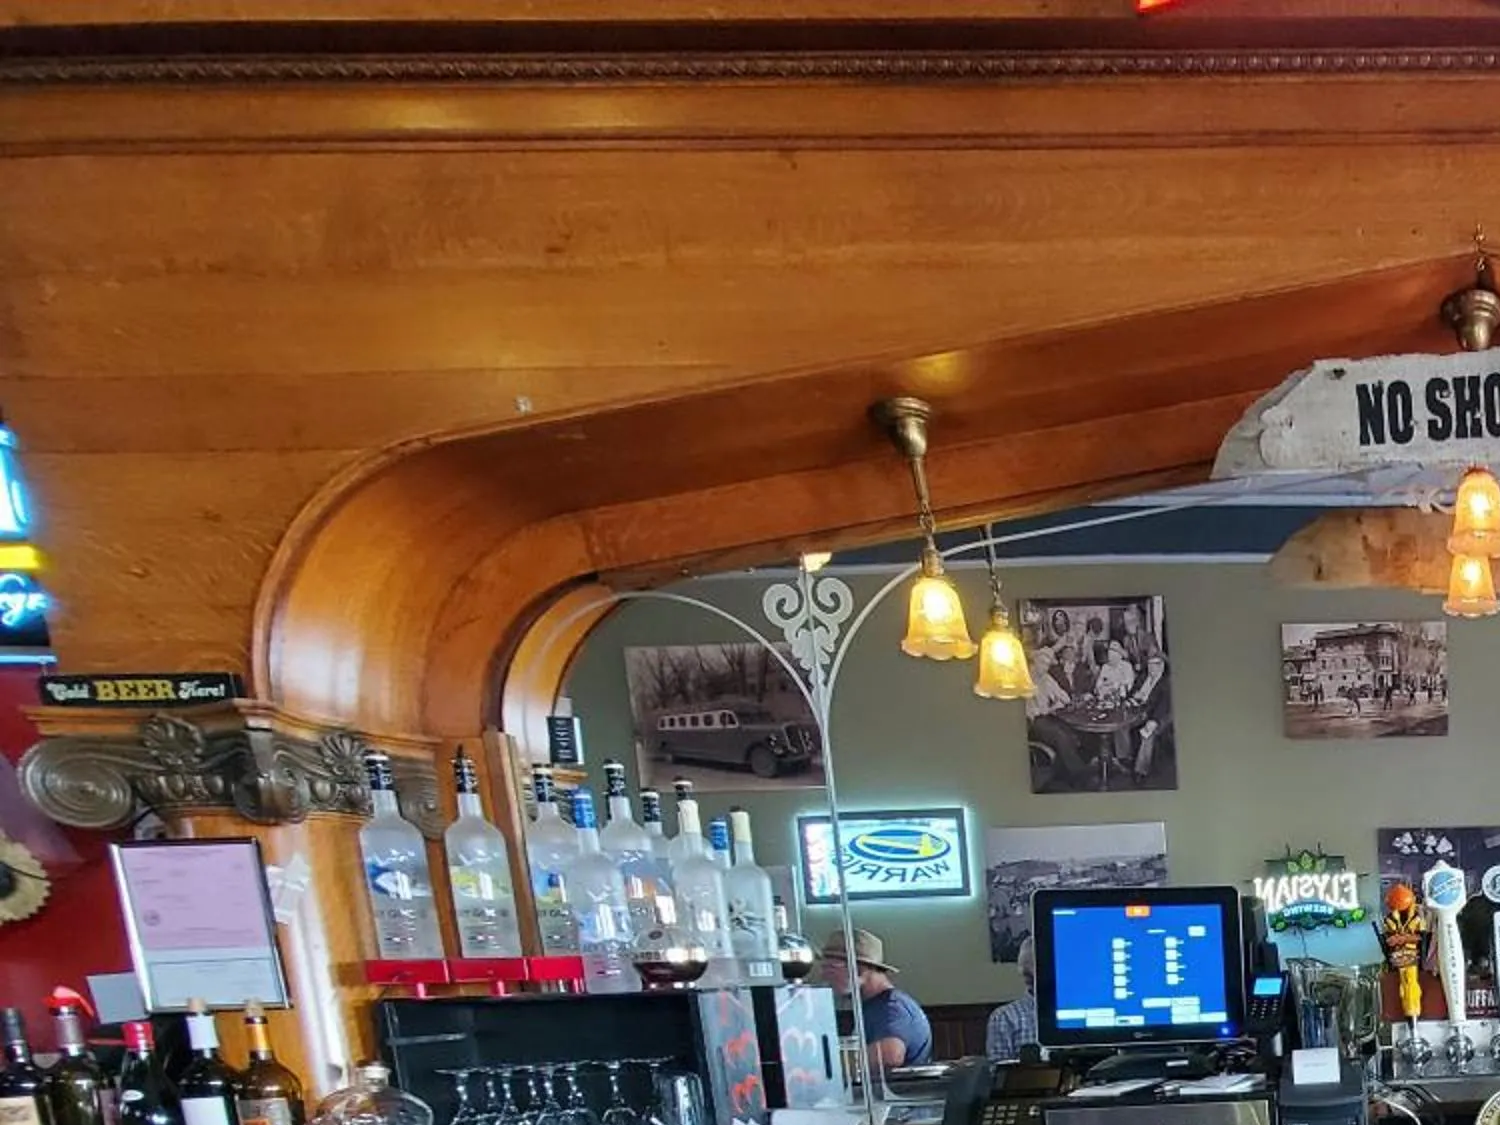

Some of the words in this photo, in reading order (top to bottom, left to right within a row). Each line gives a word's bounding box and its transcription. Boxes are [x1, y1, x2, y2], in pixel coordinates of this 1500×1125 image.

[1355, 380, 1416, 447] NO
[46, 682, 90, 700] Cold
[93, 680, 176, 701] BEER
